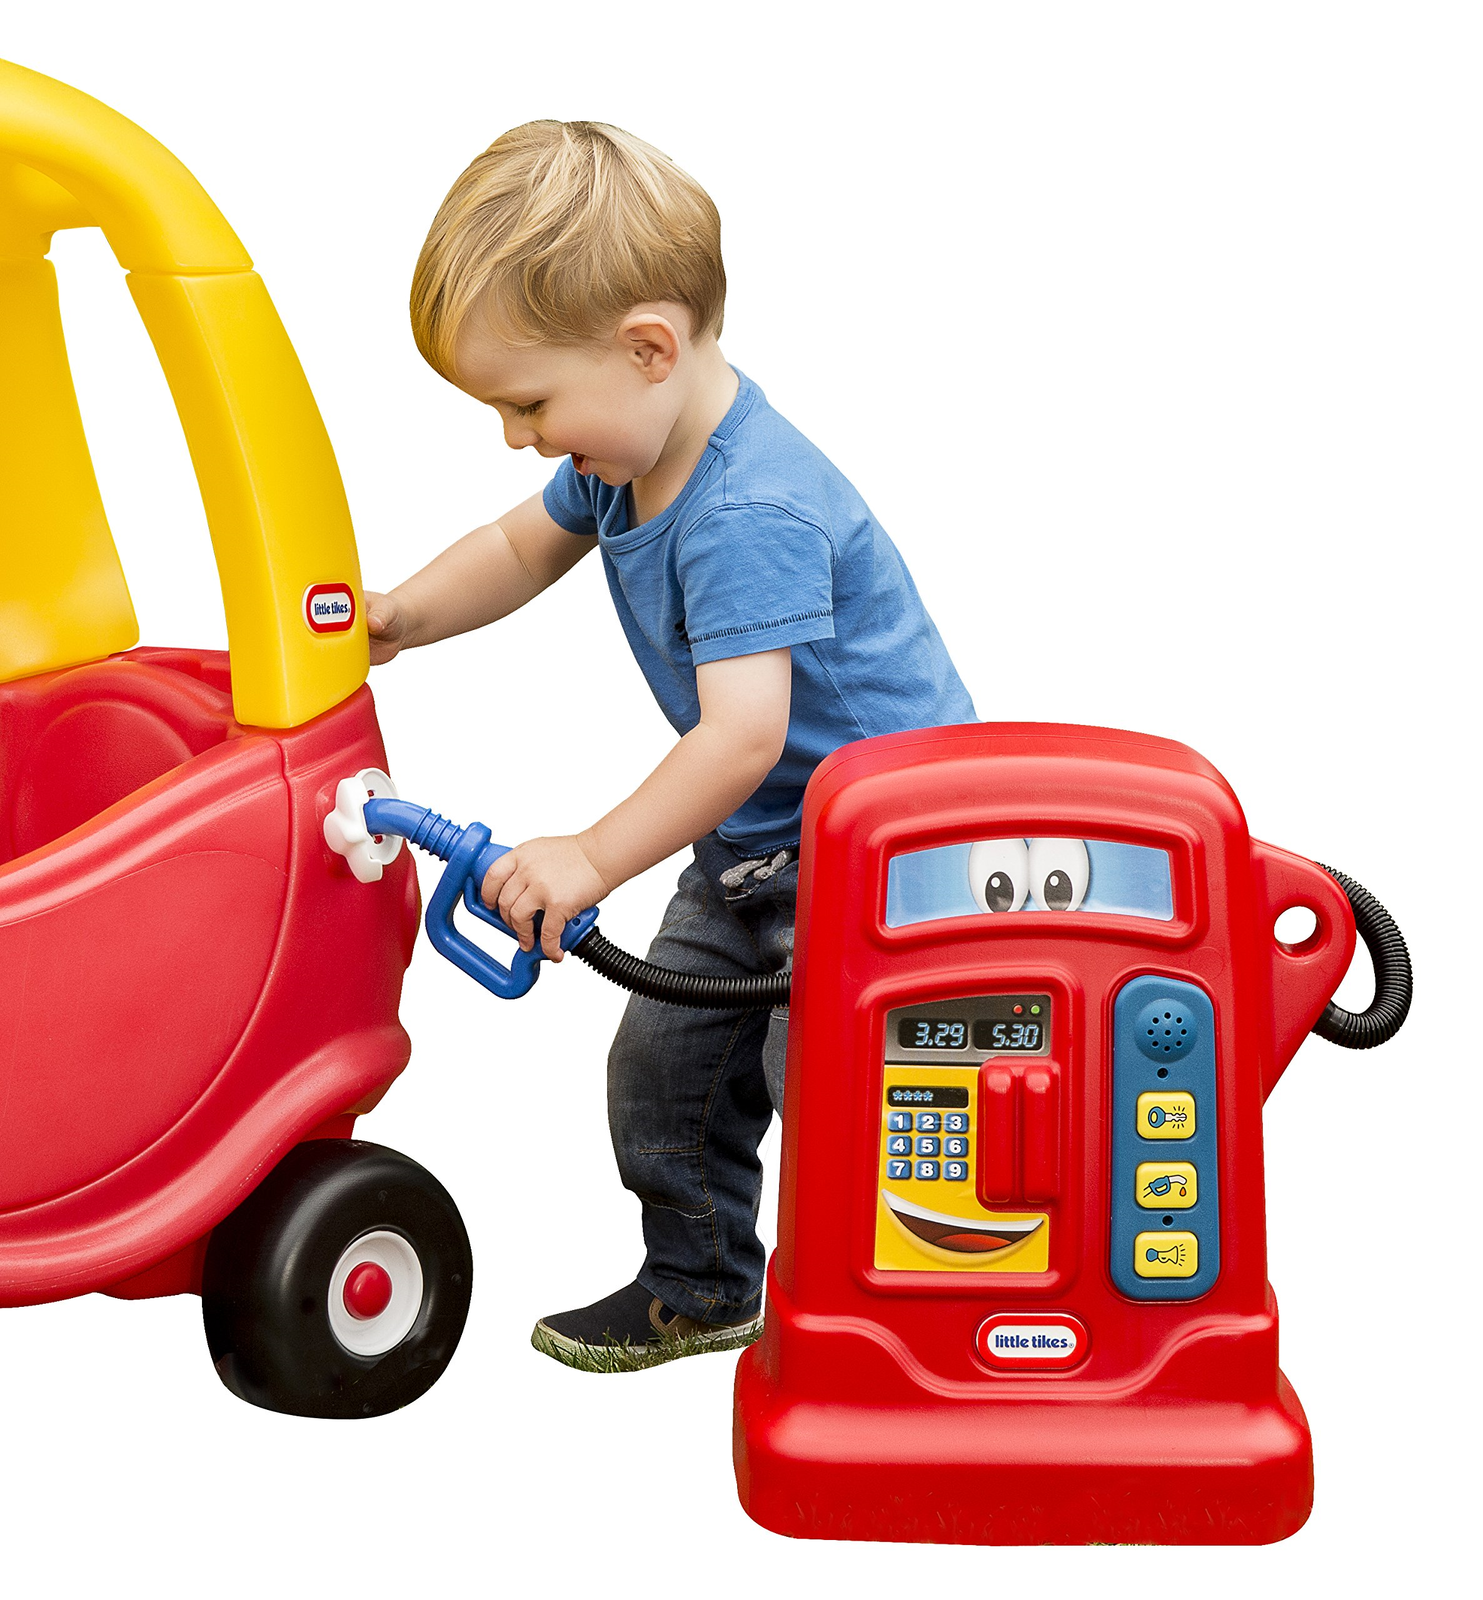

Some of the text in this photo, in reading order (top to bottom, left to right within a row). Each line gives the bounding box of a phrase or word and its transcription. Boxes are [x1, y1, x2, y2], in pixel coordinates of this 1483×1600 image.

[314, 602, 331, 616] little
[915, 1022, 1039, 1047] 3.29 5.30
[893, 1114, 962, 1130] 1 2 3
[892, 1138, 962, 1154] 4 5 6
[892, 1162, 962, 1178] 7 8 9
[995, 1334, 1030, 1348] little
